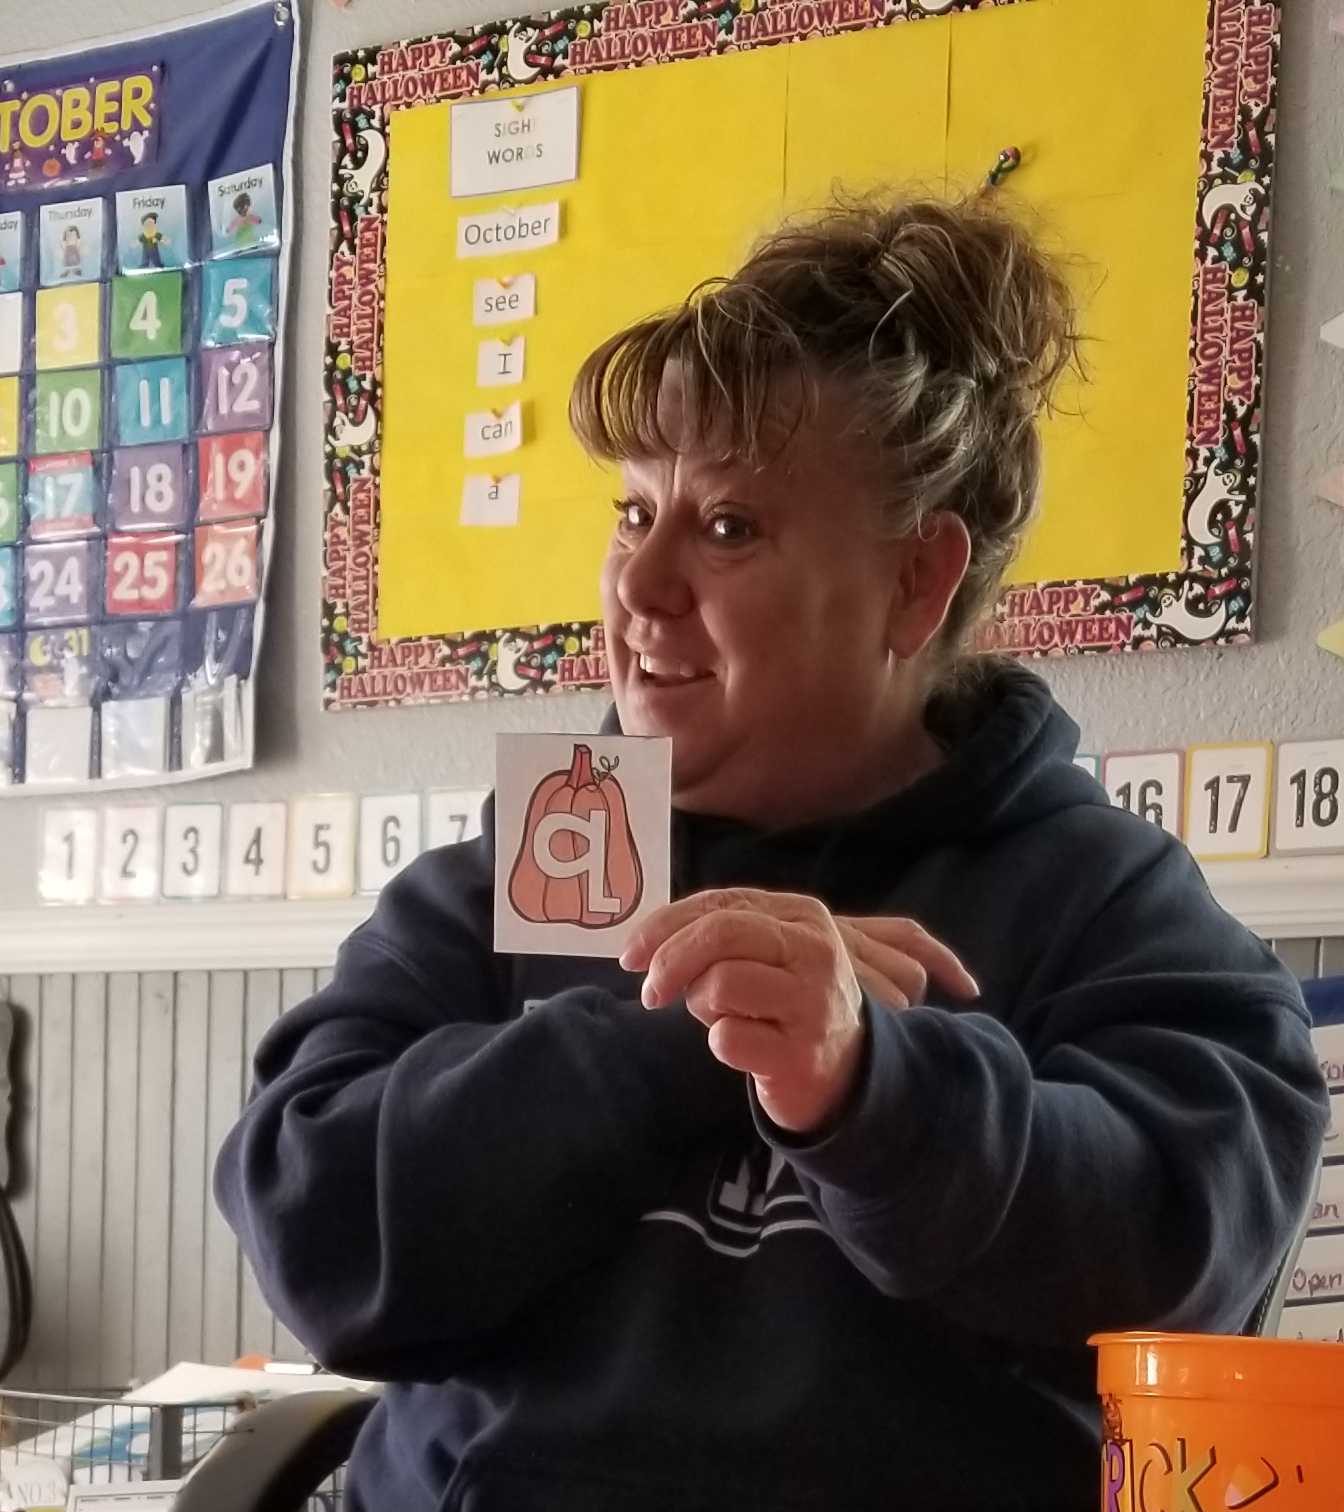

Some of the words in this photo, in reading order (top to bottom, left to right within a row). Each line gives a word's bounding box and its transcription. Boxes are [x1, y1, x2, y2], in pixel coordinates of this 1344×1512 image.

[569, 20, 719, 66] HALLOWEEN
[734, 0, 887, 43] HALLOWEEN
[347, 62, 482, 108] HALLOWEEN
[379, 39, 450, 75] HAPPY
[1244, 5, 1272, 106] HAPPY
[48, 205, 93, 219] Thursday
[132, 195, 165, 209] Friday
[217, 175, 263, 197] Saturday
[465, 215, 551, 245] October
[53, 303, 80, 350] 3
[129, 291, 161, 340] 4
[220, 278, 249, 328] 5
[331, 252, 355, 341] HAPPY
[352, 214, 380, 373] HALLOWEEN
[484, 293, 519, 312] see
[497, 353, 512, 375] I
[1194, 263, 1228, 448] HALLOWEEN
[1226, 301, 1255, 403] HAPPY
[47, 388, 90, 438] 10
[139, 376, 172, 427] 11
[217, 362, 261, 415] 12
[481, 420, 513, 441] can
[45, 471, 83, 519] 17
[129, 462, 174, 514] 18
[213, 447, 256, 501] 19
[488, 485, 499, 500] a
[27, 556, 81, 609] 24
[112, 550, 167, 599] 25
[201, 540, 251, 591] 26
[327, 513, 347, 600] HAPPY
[350, 476, 371, 634] HALLOWEEN
[1007, 585, 1097, 618] HAPPY
[339, 666, 469, 699] HALLOWEEN
[369, 640, 441, 668] HAPPY
[1115, 779, 1163, 832] 16
[1204, 774, 1251, 834] 17
[1289, 766, 1339, 828] 18
[61, 830, 76, 880] 1
[120, 828, 139, 879] 2
[182, 826, 200, 876] 3
[243, 826, 264, 876] 4
[311, 823, 331, 874] 5
[381, 815, 401, 867] 6
[533, 809, 622, 913] q
